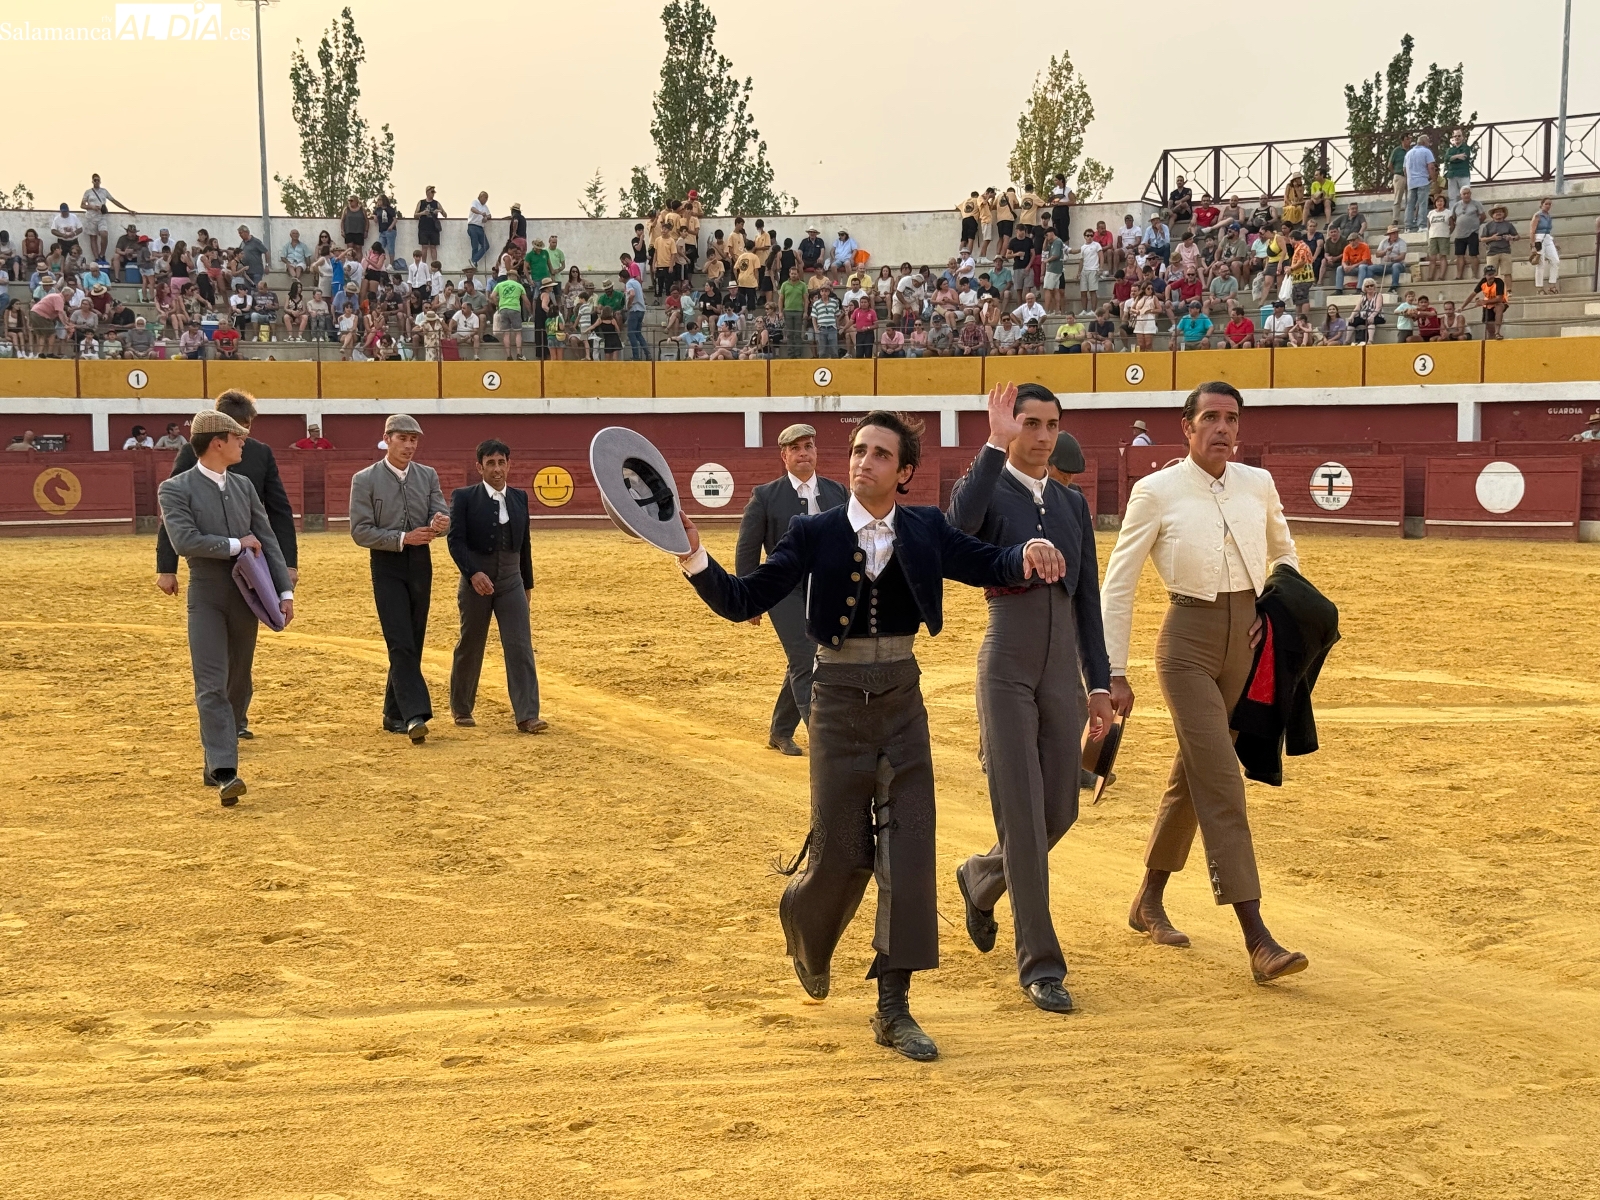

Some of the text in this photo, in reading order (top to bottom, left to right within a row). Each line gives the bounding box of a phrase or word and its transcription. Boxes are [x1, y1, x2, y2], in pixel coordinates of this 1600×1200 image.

[1419, 357, 1427, 372] 3
[134, 373, 140, 386] 1
[487, 374, 496, 386] 2
[819, 370, 828, 382] 2
[1130, 367, 1139, 381] 2
[1547, 407, 1583, 415] GUARDIA
